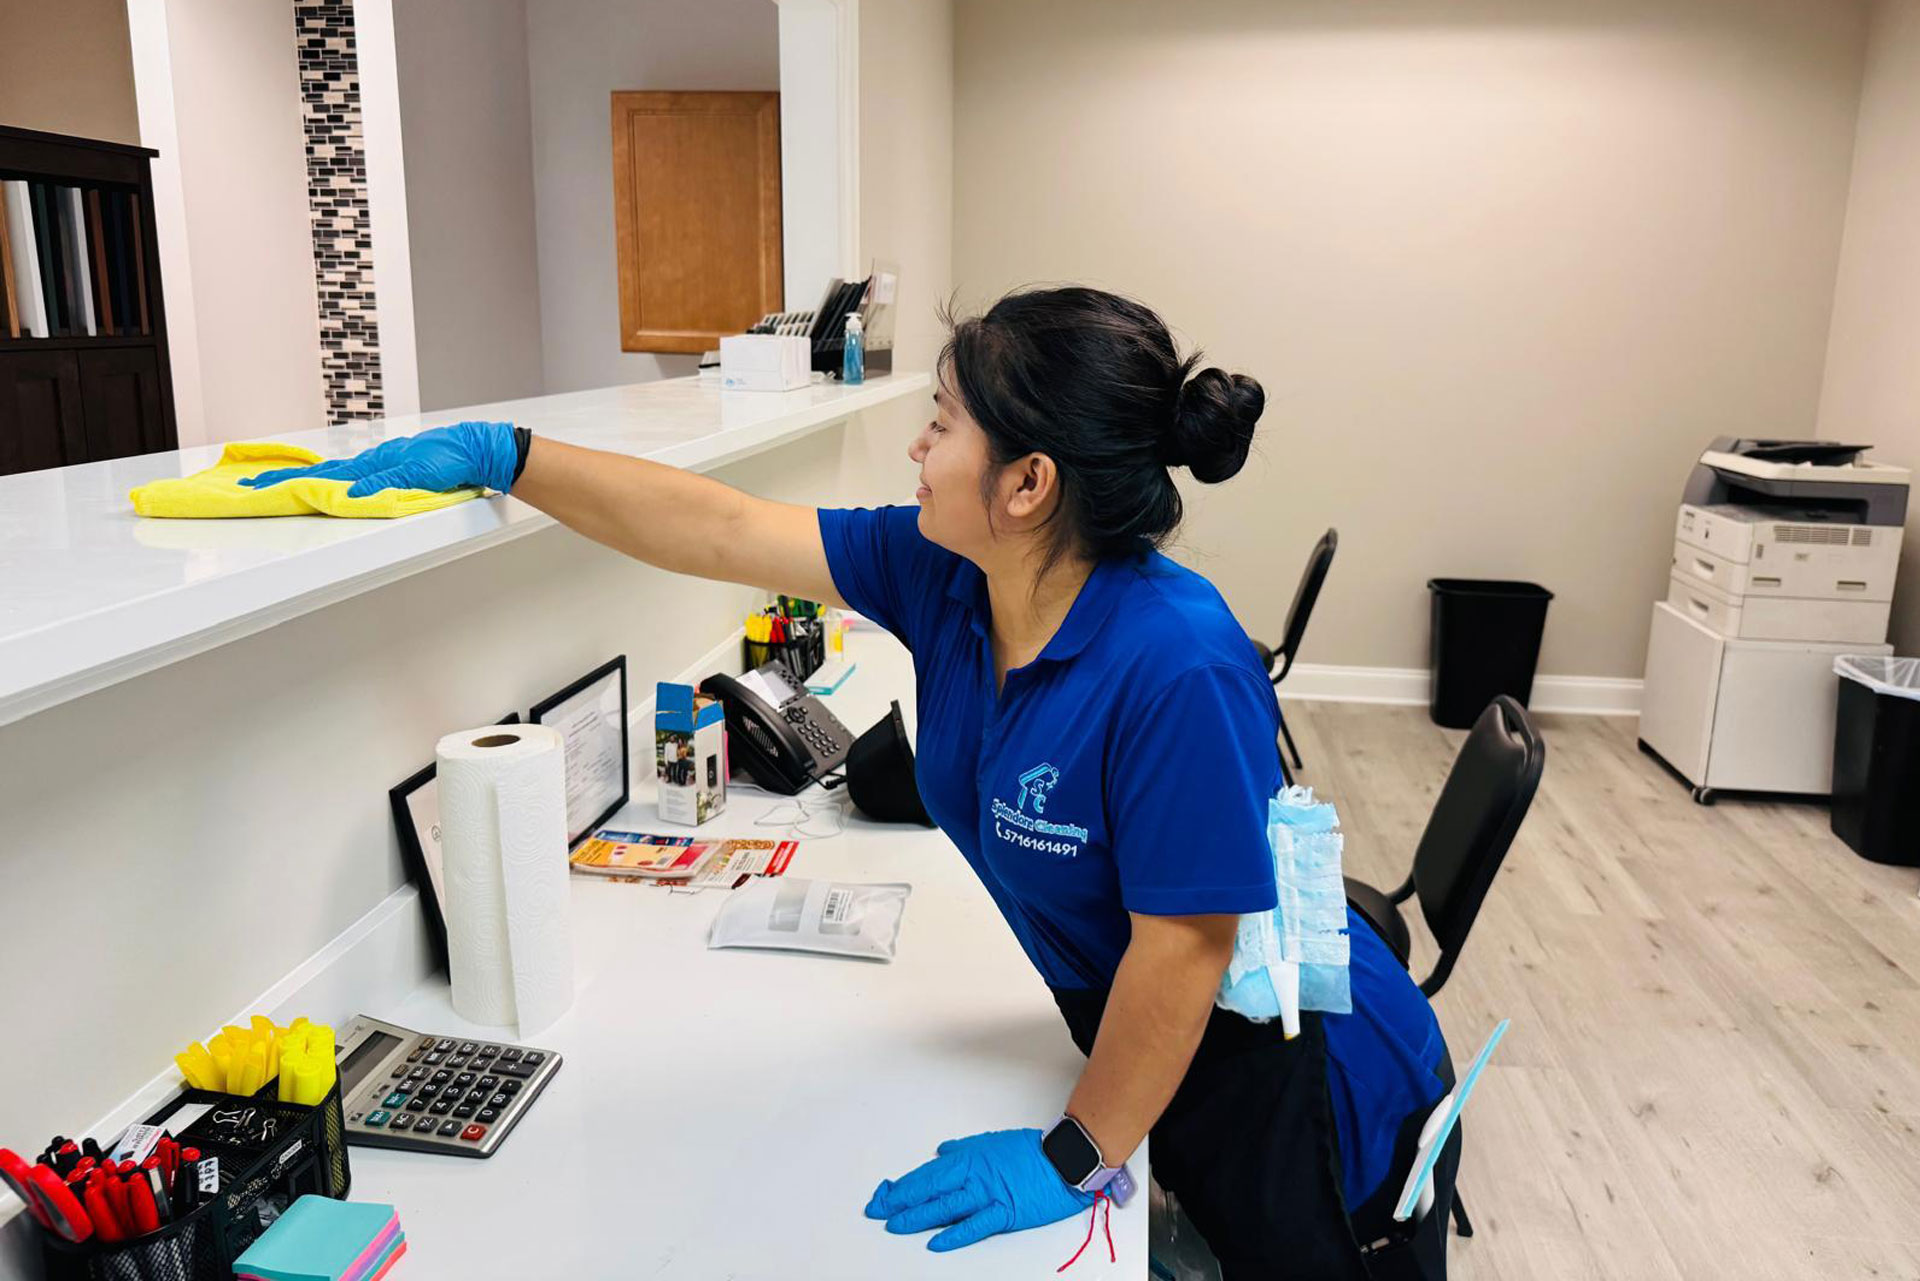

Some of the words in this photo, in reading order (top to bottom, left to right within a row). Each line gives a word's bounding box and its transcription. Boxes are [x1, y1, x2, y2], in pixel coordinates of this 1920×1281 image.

[1034, 819, 1088, 844] Cleaning
[1003, 828, 1078, 857] 5716161491
[492, 1093, 506, 1104] 00
[436, 1101, 447, 1109] 4
[467, 1126, 480, 1134] C
